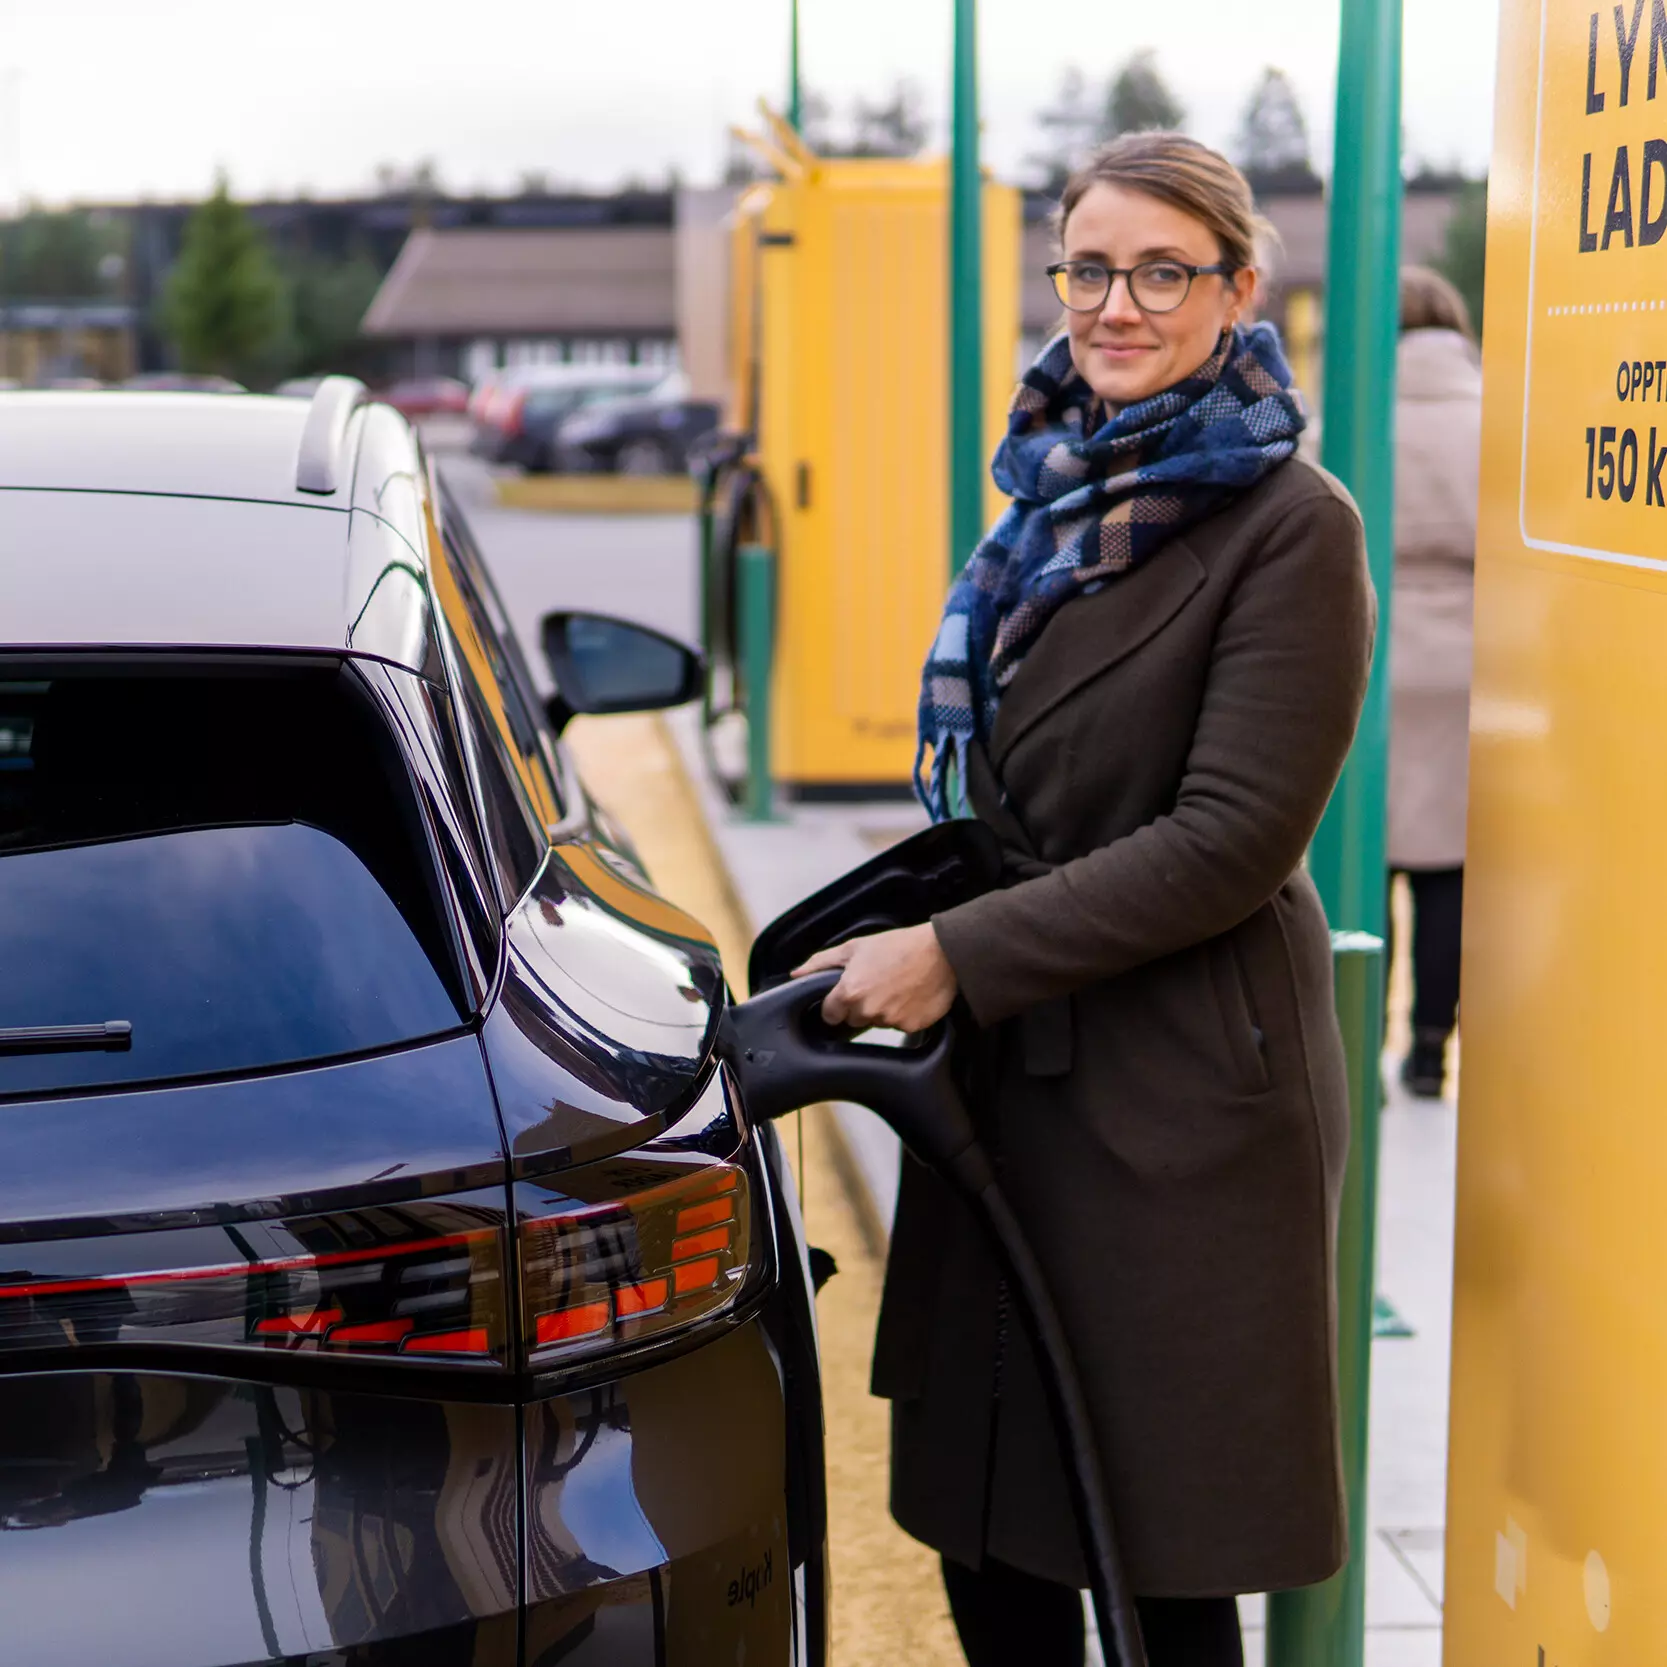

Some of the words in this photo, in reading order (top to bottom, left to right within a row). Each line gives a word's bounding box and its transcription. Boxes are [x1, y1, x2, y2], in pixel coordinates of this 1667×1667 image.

[1578, 138, 1667, 254] LAD
[1616, 360, 1667, 402] OPPT
[1585, 426, 1638, 503] 150
